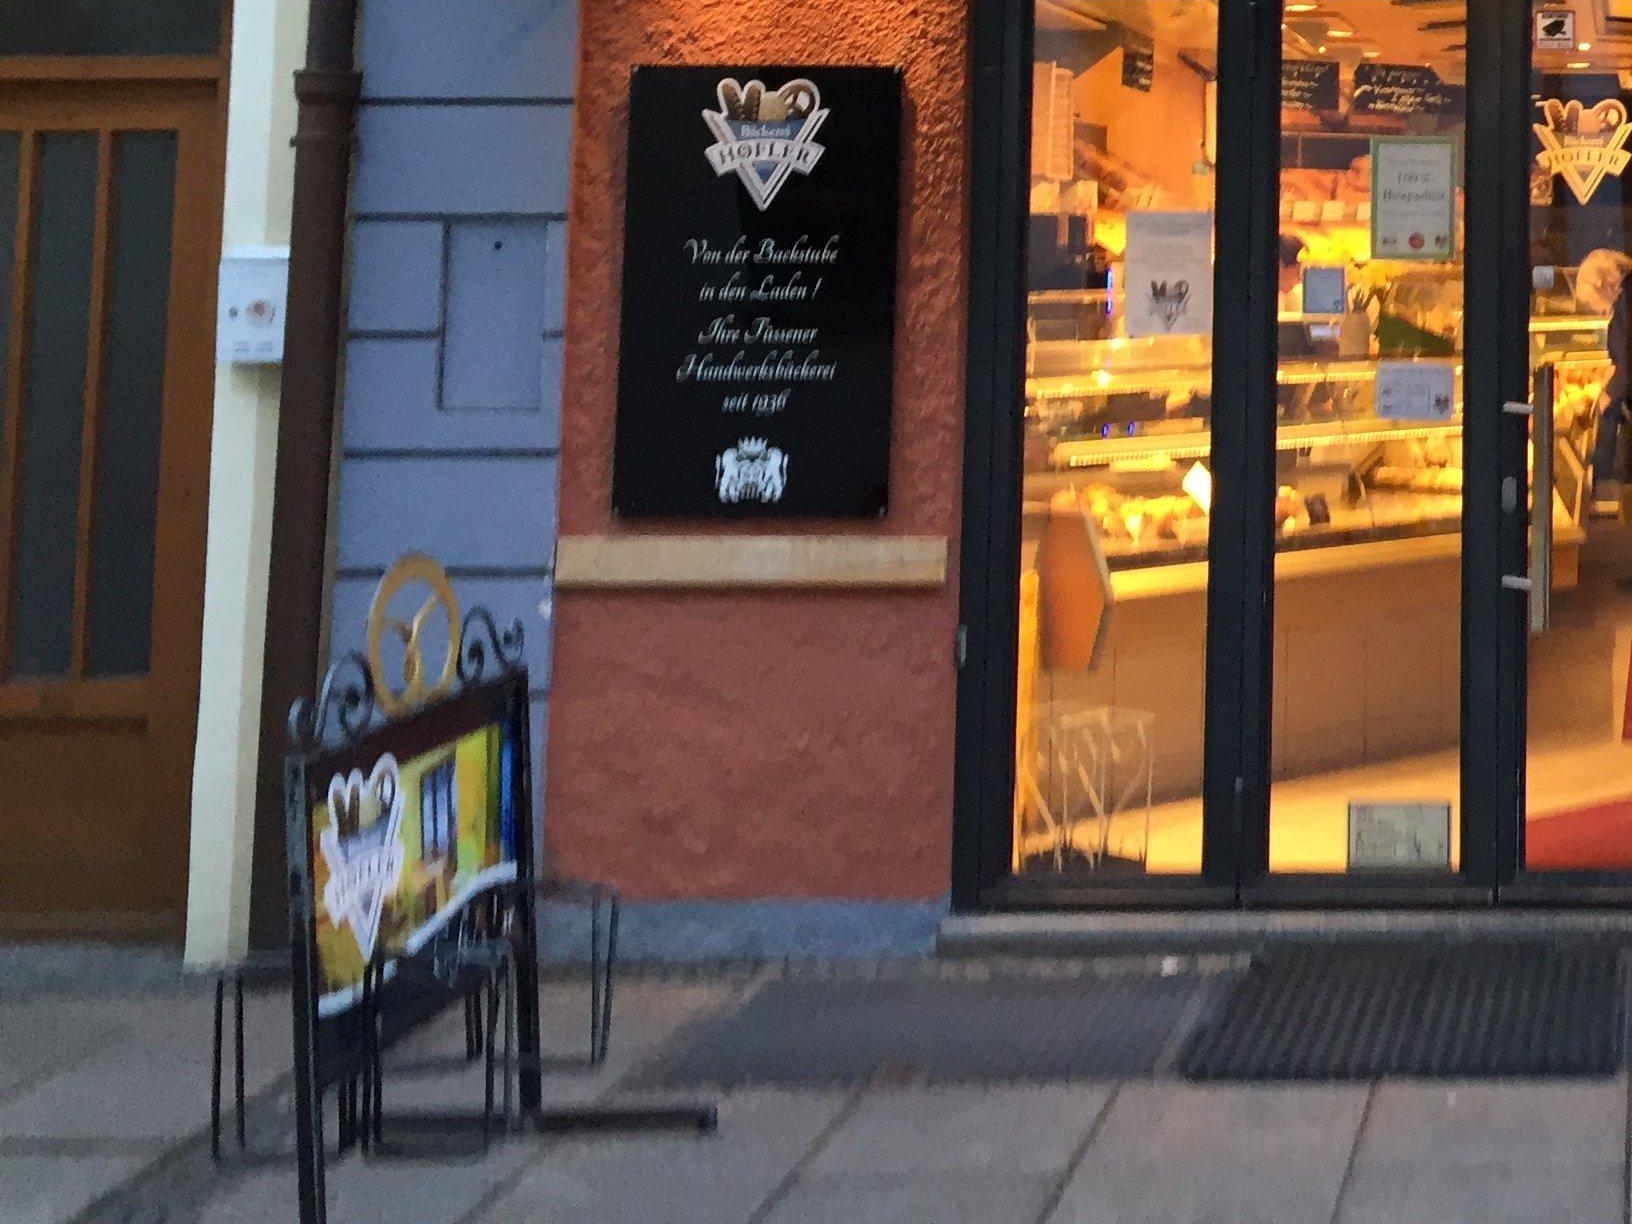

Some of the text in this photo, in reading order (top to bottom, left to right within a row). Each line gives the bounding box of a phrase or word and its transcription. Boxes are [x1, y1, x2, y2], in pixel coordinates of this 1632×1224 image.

[683, 234, 840, 264] Von der Backstube
[699, 282, 715, 302] in
[718, 271, 747, 302] den
[750, 271, 809, 302] Laden
[697, 313, 741, 345] Ihre
[721, 392, 749, 414] seit
